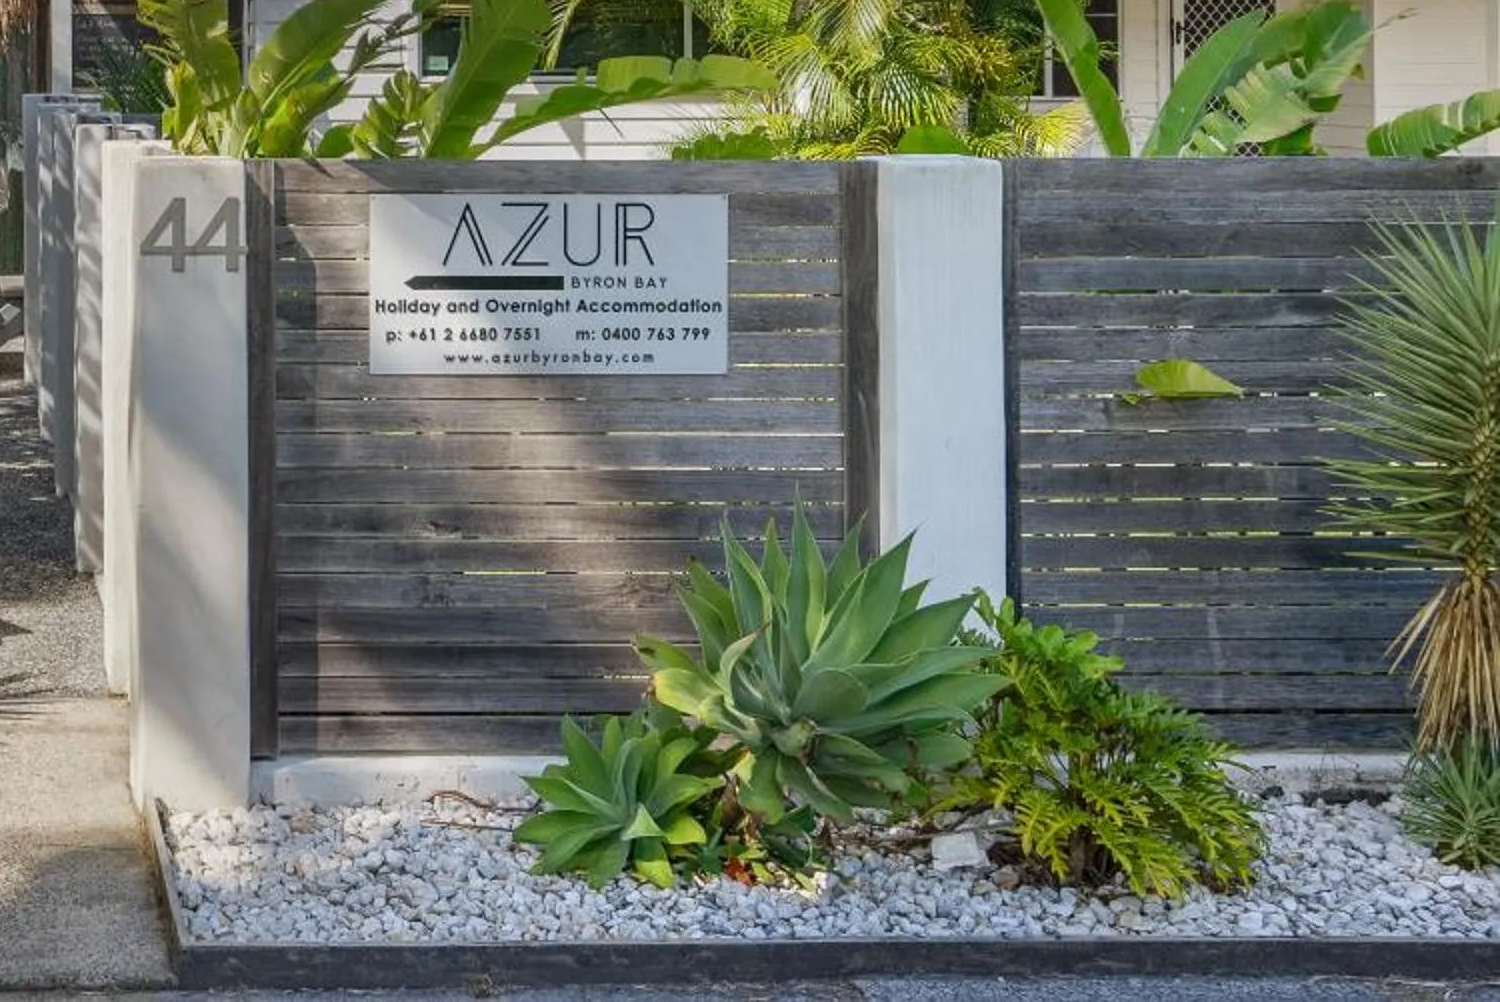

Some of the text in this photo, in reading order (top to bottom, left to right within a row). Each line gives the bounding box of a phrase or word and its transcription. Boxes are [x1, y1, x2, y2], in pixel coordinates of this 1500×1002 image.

[139, 196, 248, 274] 44
[442, 201, 656, 267] AZUR
[571, 276, 668, 289] BYRON BAY
[375, 298, 723, 317] Holiday and Overnight Accommodation
[386, 326, 710, 343] p: +61 2 6680 7551 m: 0400 763 799
[443, 349, 655, 367] www.azurbyronbay.com
